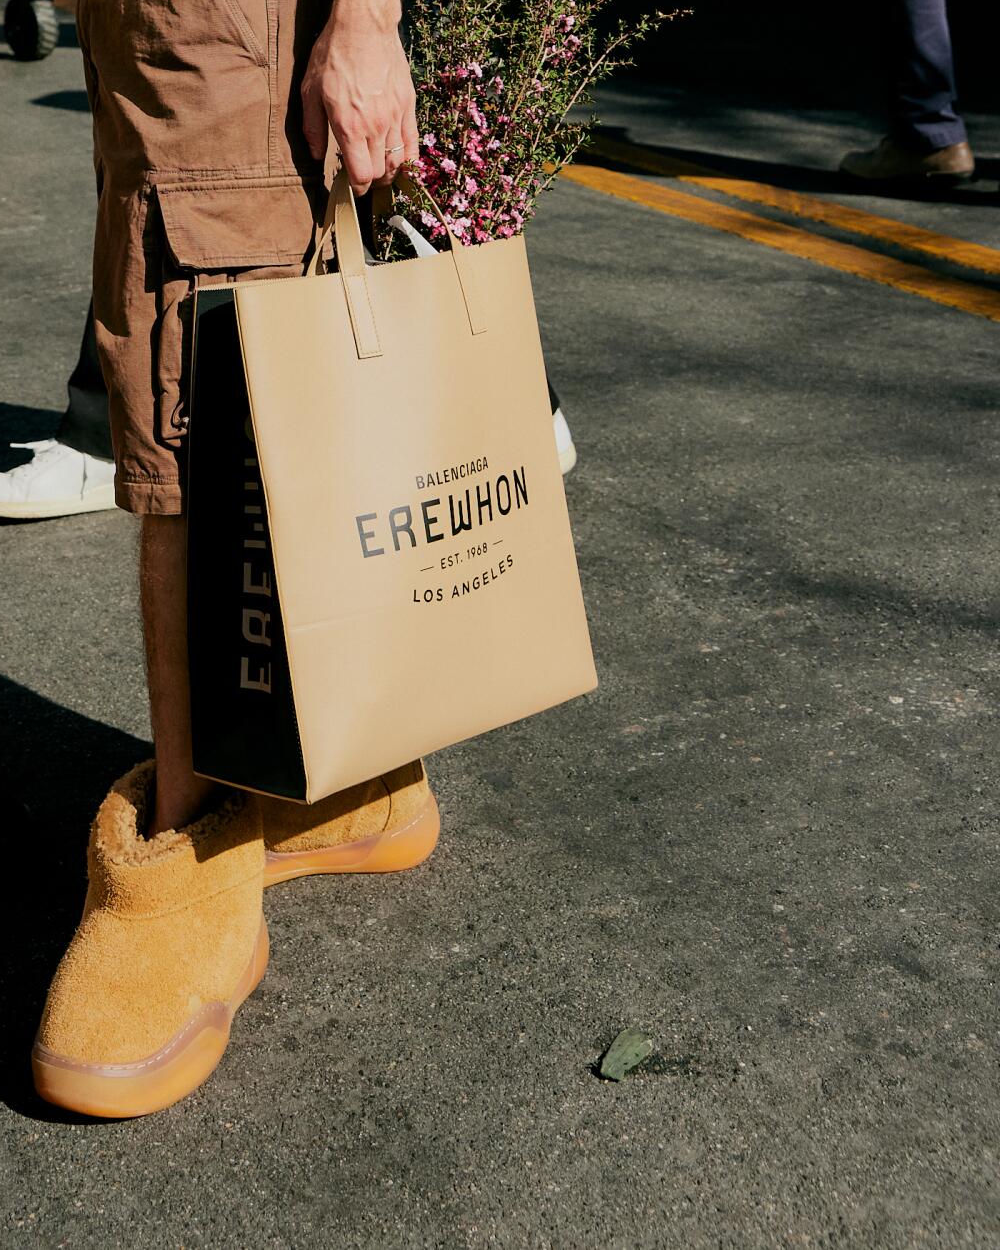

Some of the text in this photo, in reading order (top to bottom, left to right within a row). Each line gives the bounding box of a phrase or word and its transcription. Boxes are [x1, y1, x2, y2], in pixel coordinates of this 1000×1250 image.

[415, 456, 489, 490] BALENCIAGA
[355, 466, 529, 558] EREWHON
[440, 542, 488, 570] EST. 1968
[413, 554, 514, 603] LOS ANGELES
